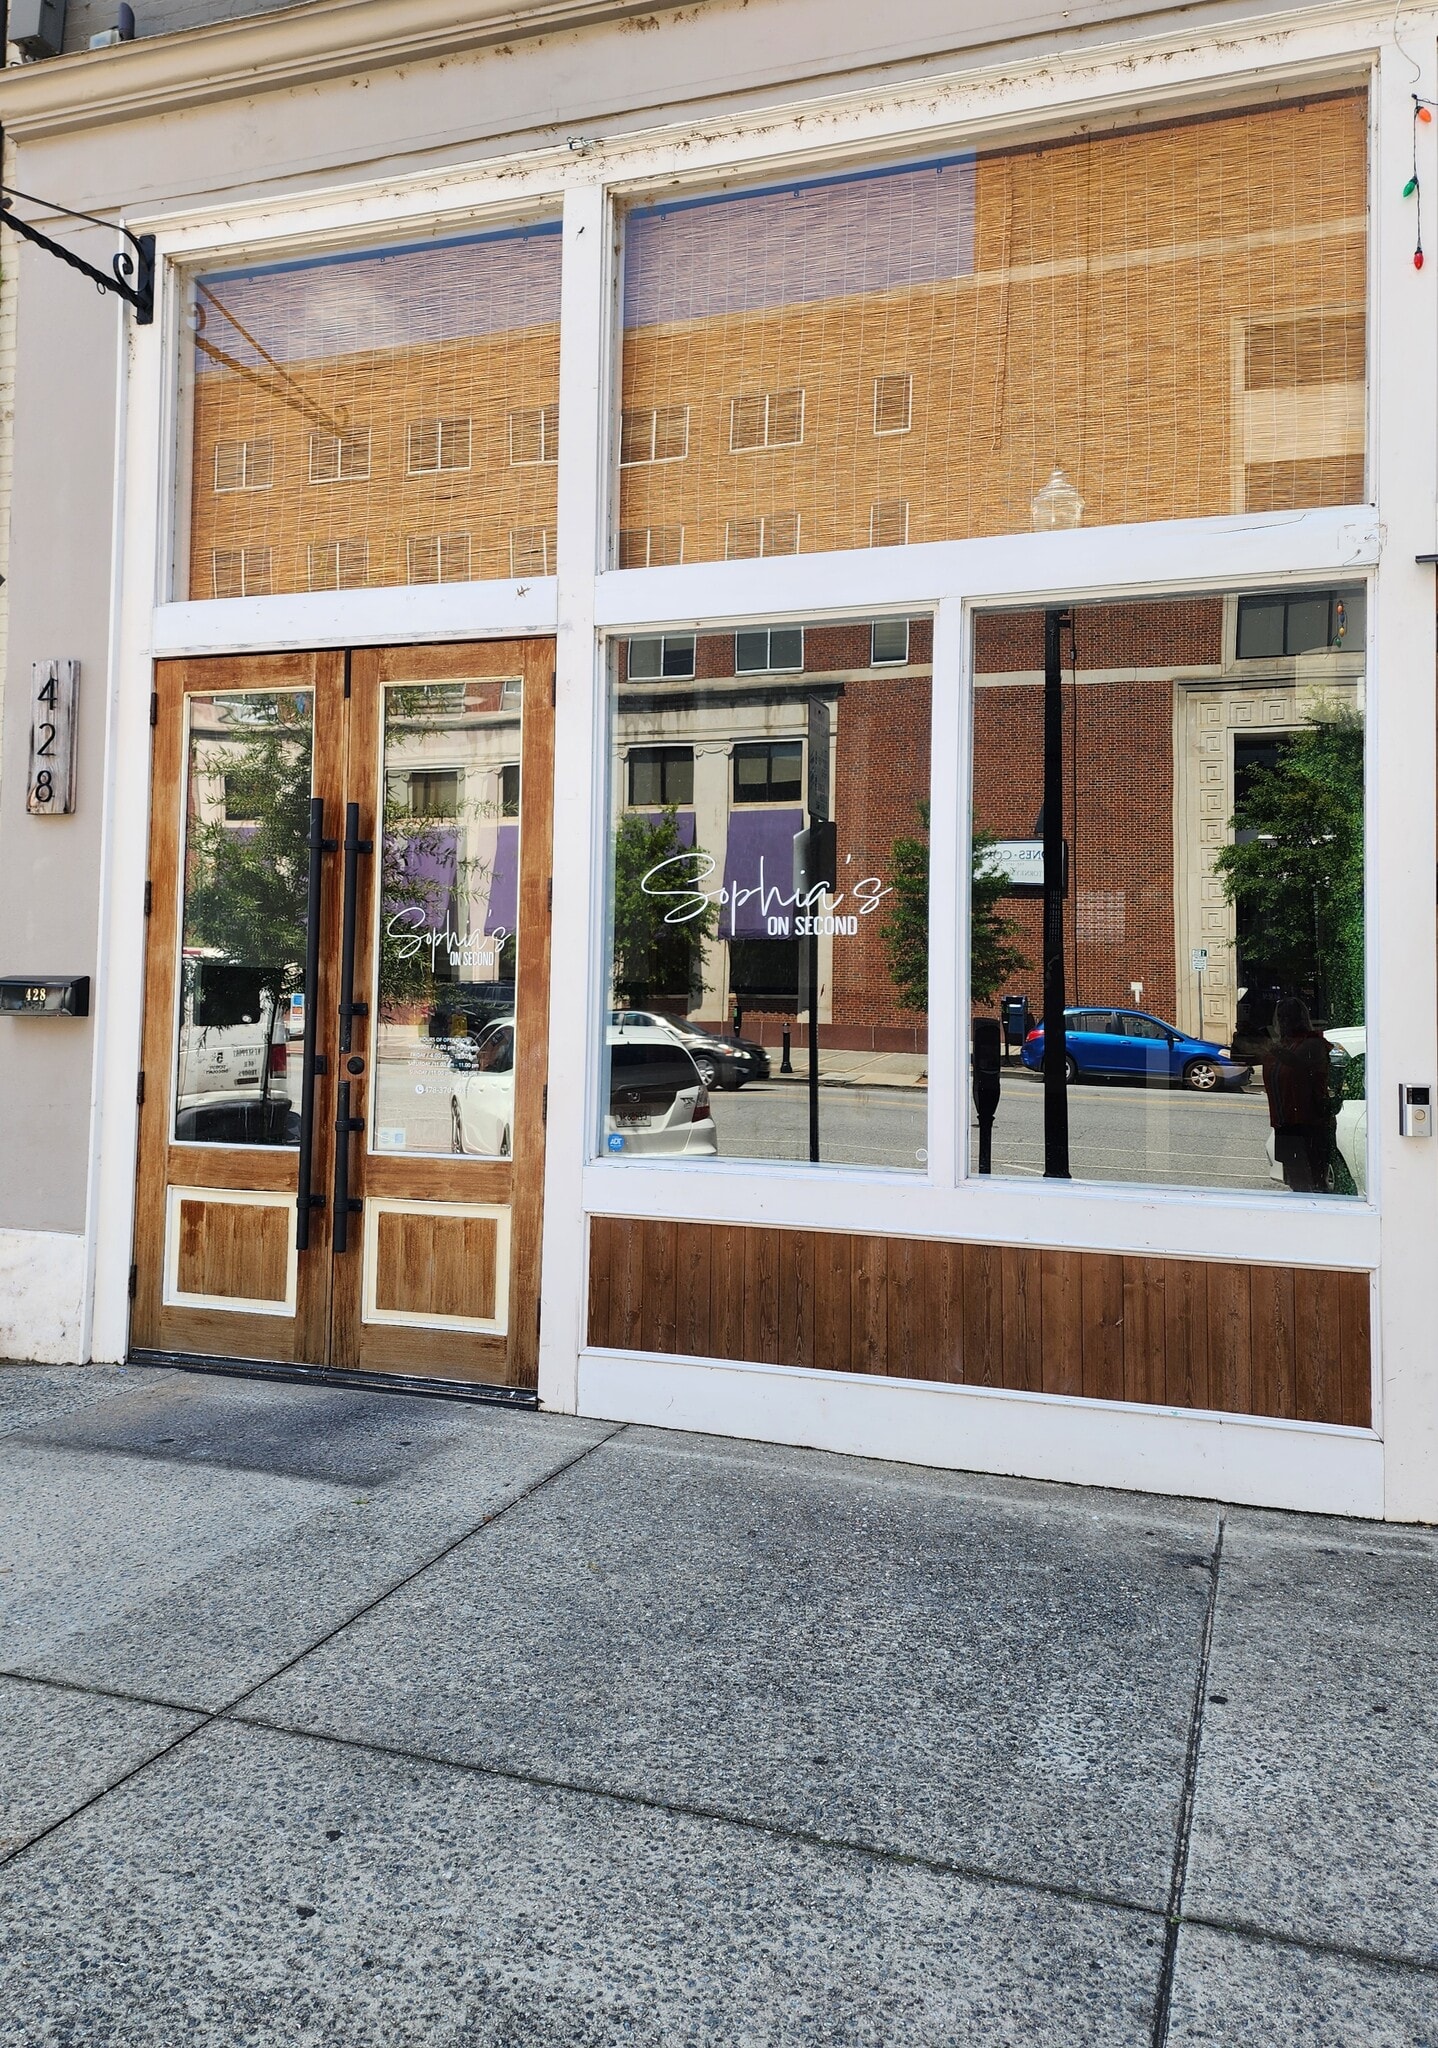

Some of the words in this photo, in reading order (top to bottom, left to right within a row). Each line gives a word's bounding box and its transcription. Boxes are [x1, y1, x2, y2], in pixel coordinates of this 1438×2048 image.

[36, 676, 57, 802] 428
[641, 852, 893, 936] Sophia's
[387, 907, 512, 973] Sophia's
[767, 915, 789, 936] ON
[794, 915, 858, 936] SECOND
[450, 951, 461, 966] ON
[462, 951, 494, 966] SECOND
[25, 988, 46, 1001] 428
